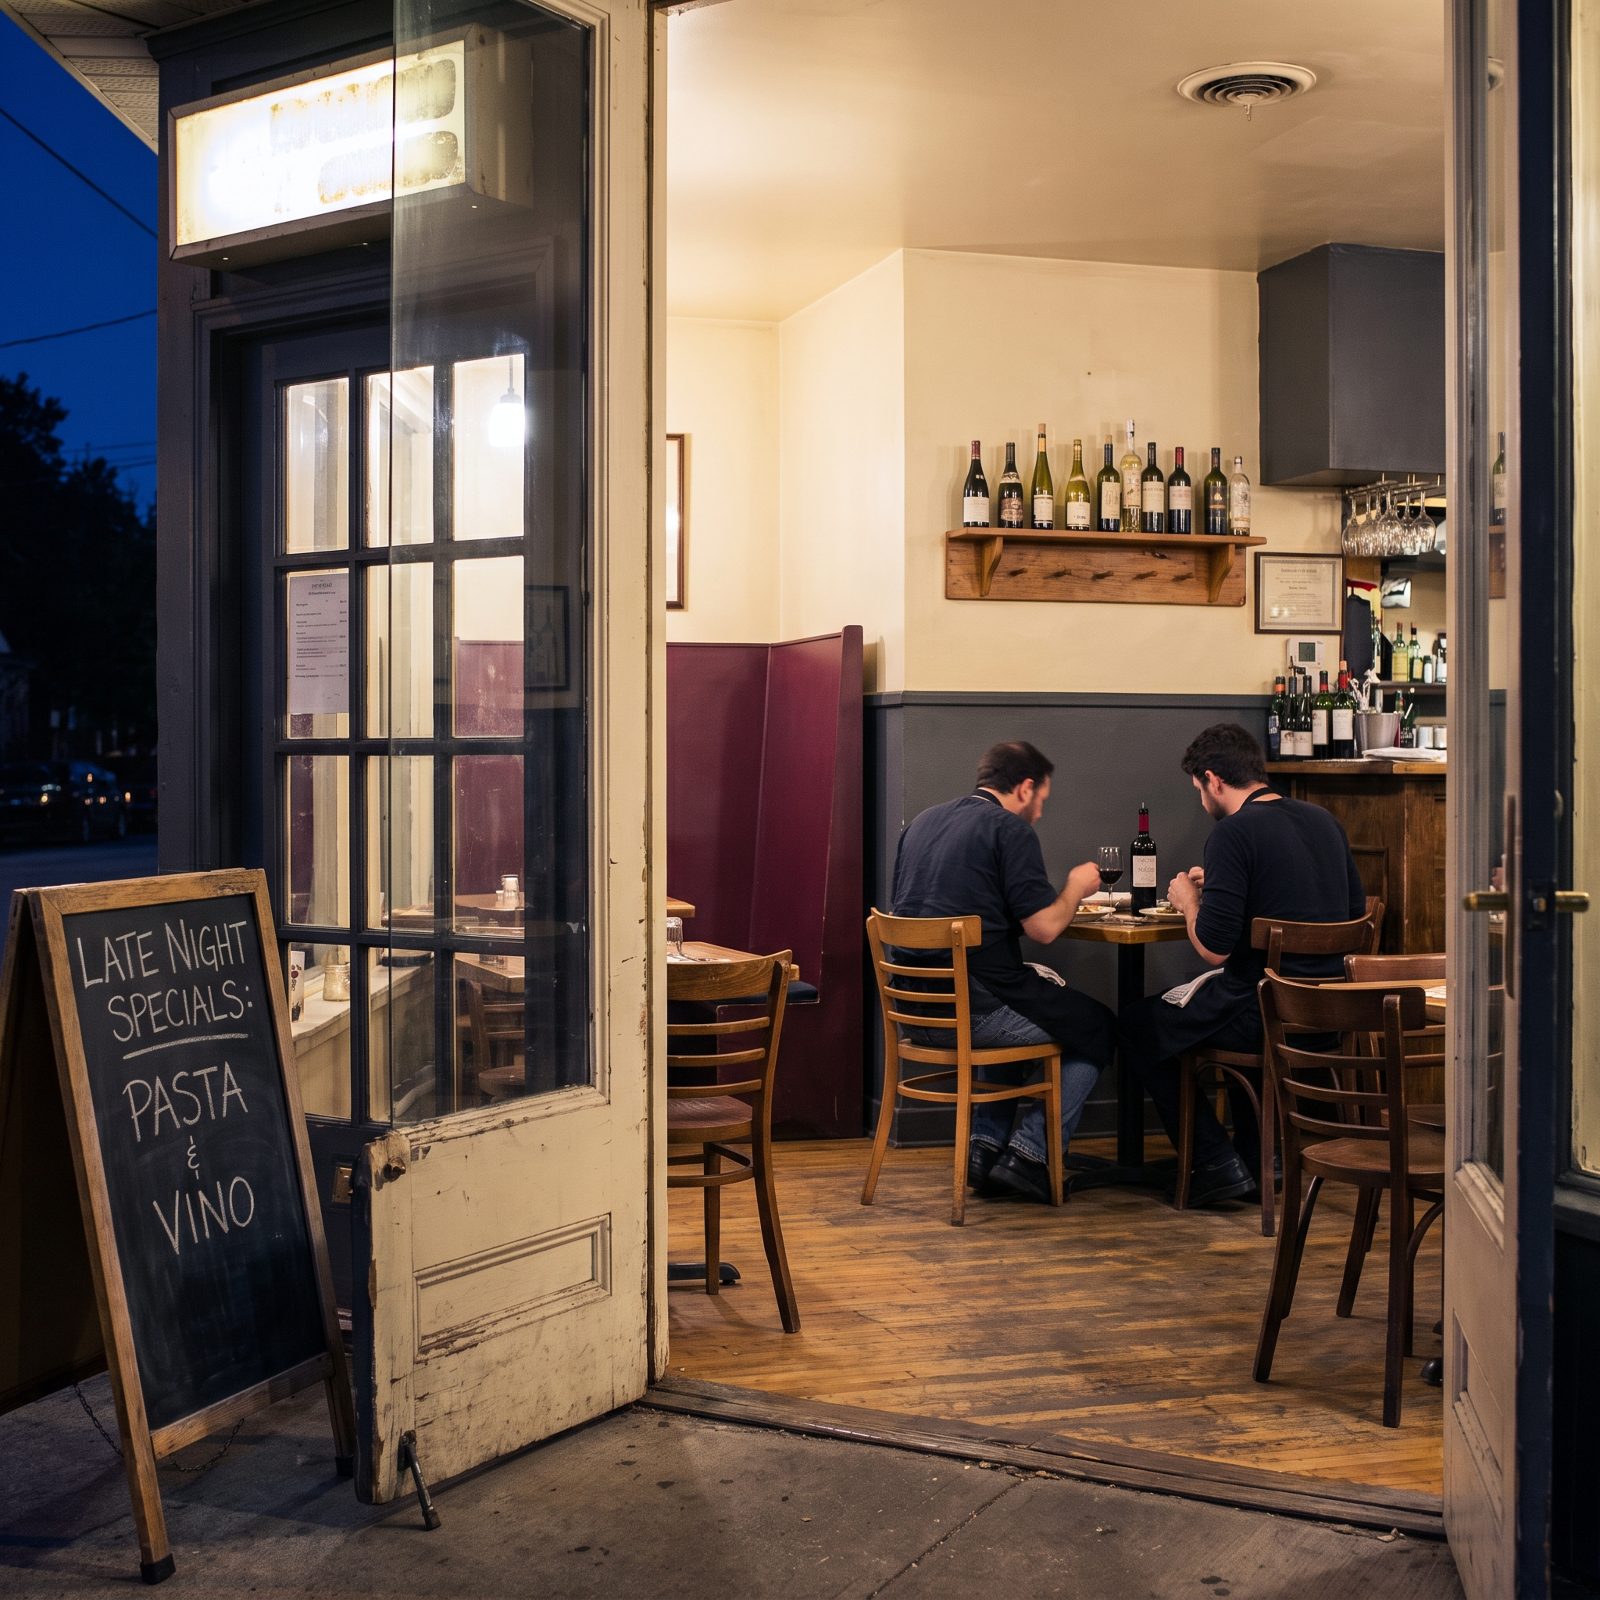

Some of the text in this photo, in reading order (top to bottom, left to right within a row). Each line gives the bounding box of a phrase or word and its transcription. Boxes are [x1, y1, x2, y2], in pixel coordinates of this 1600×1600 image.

[76, 919, 247, 989] LATE NIGHT
[107, 979, 253, 1042] SPECIALS:
[122, 1061, 249, 1142] PASTA
[187, 1135, 200, 1180] &
[152, 1176, 255, 1255] VINO
